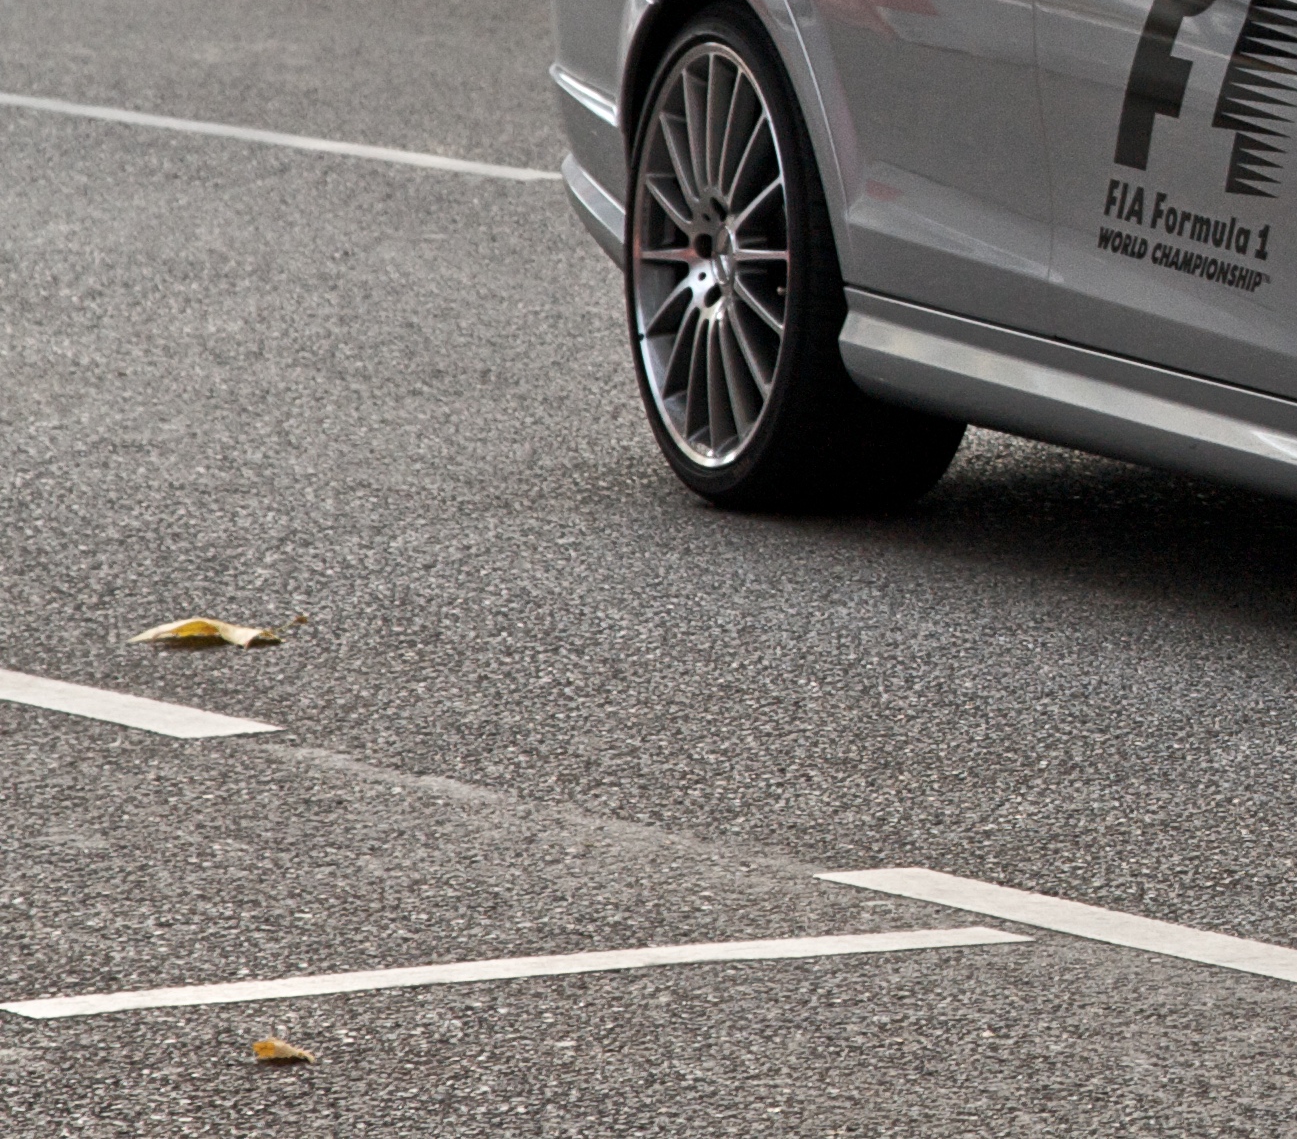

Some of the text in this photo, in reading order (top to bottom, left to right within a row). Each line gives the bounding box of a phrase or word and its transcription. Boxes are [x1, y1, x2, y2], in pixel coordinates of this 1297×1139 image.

[1098, 226, 1148, 260] WORLD
[1104, 178, 1271, 262] FIA Formula 1
